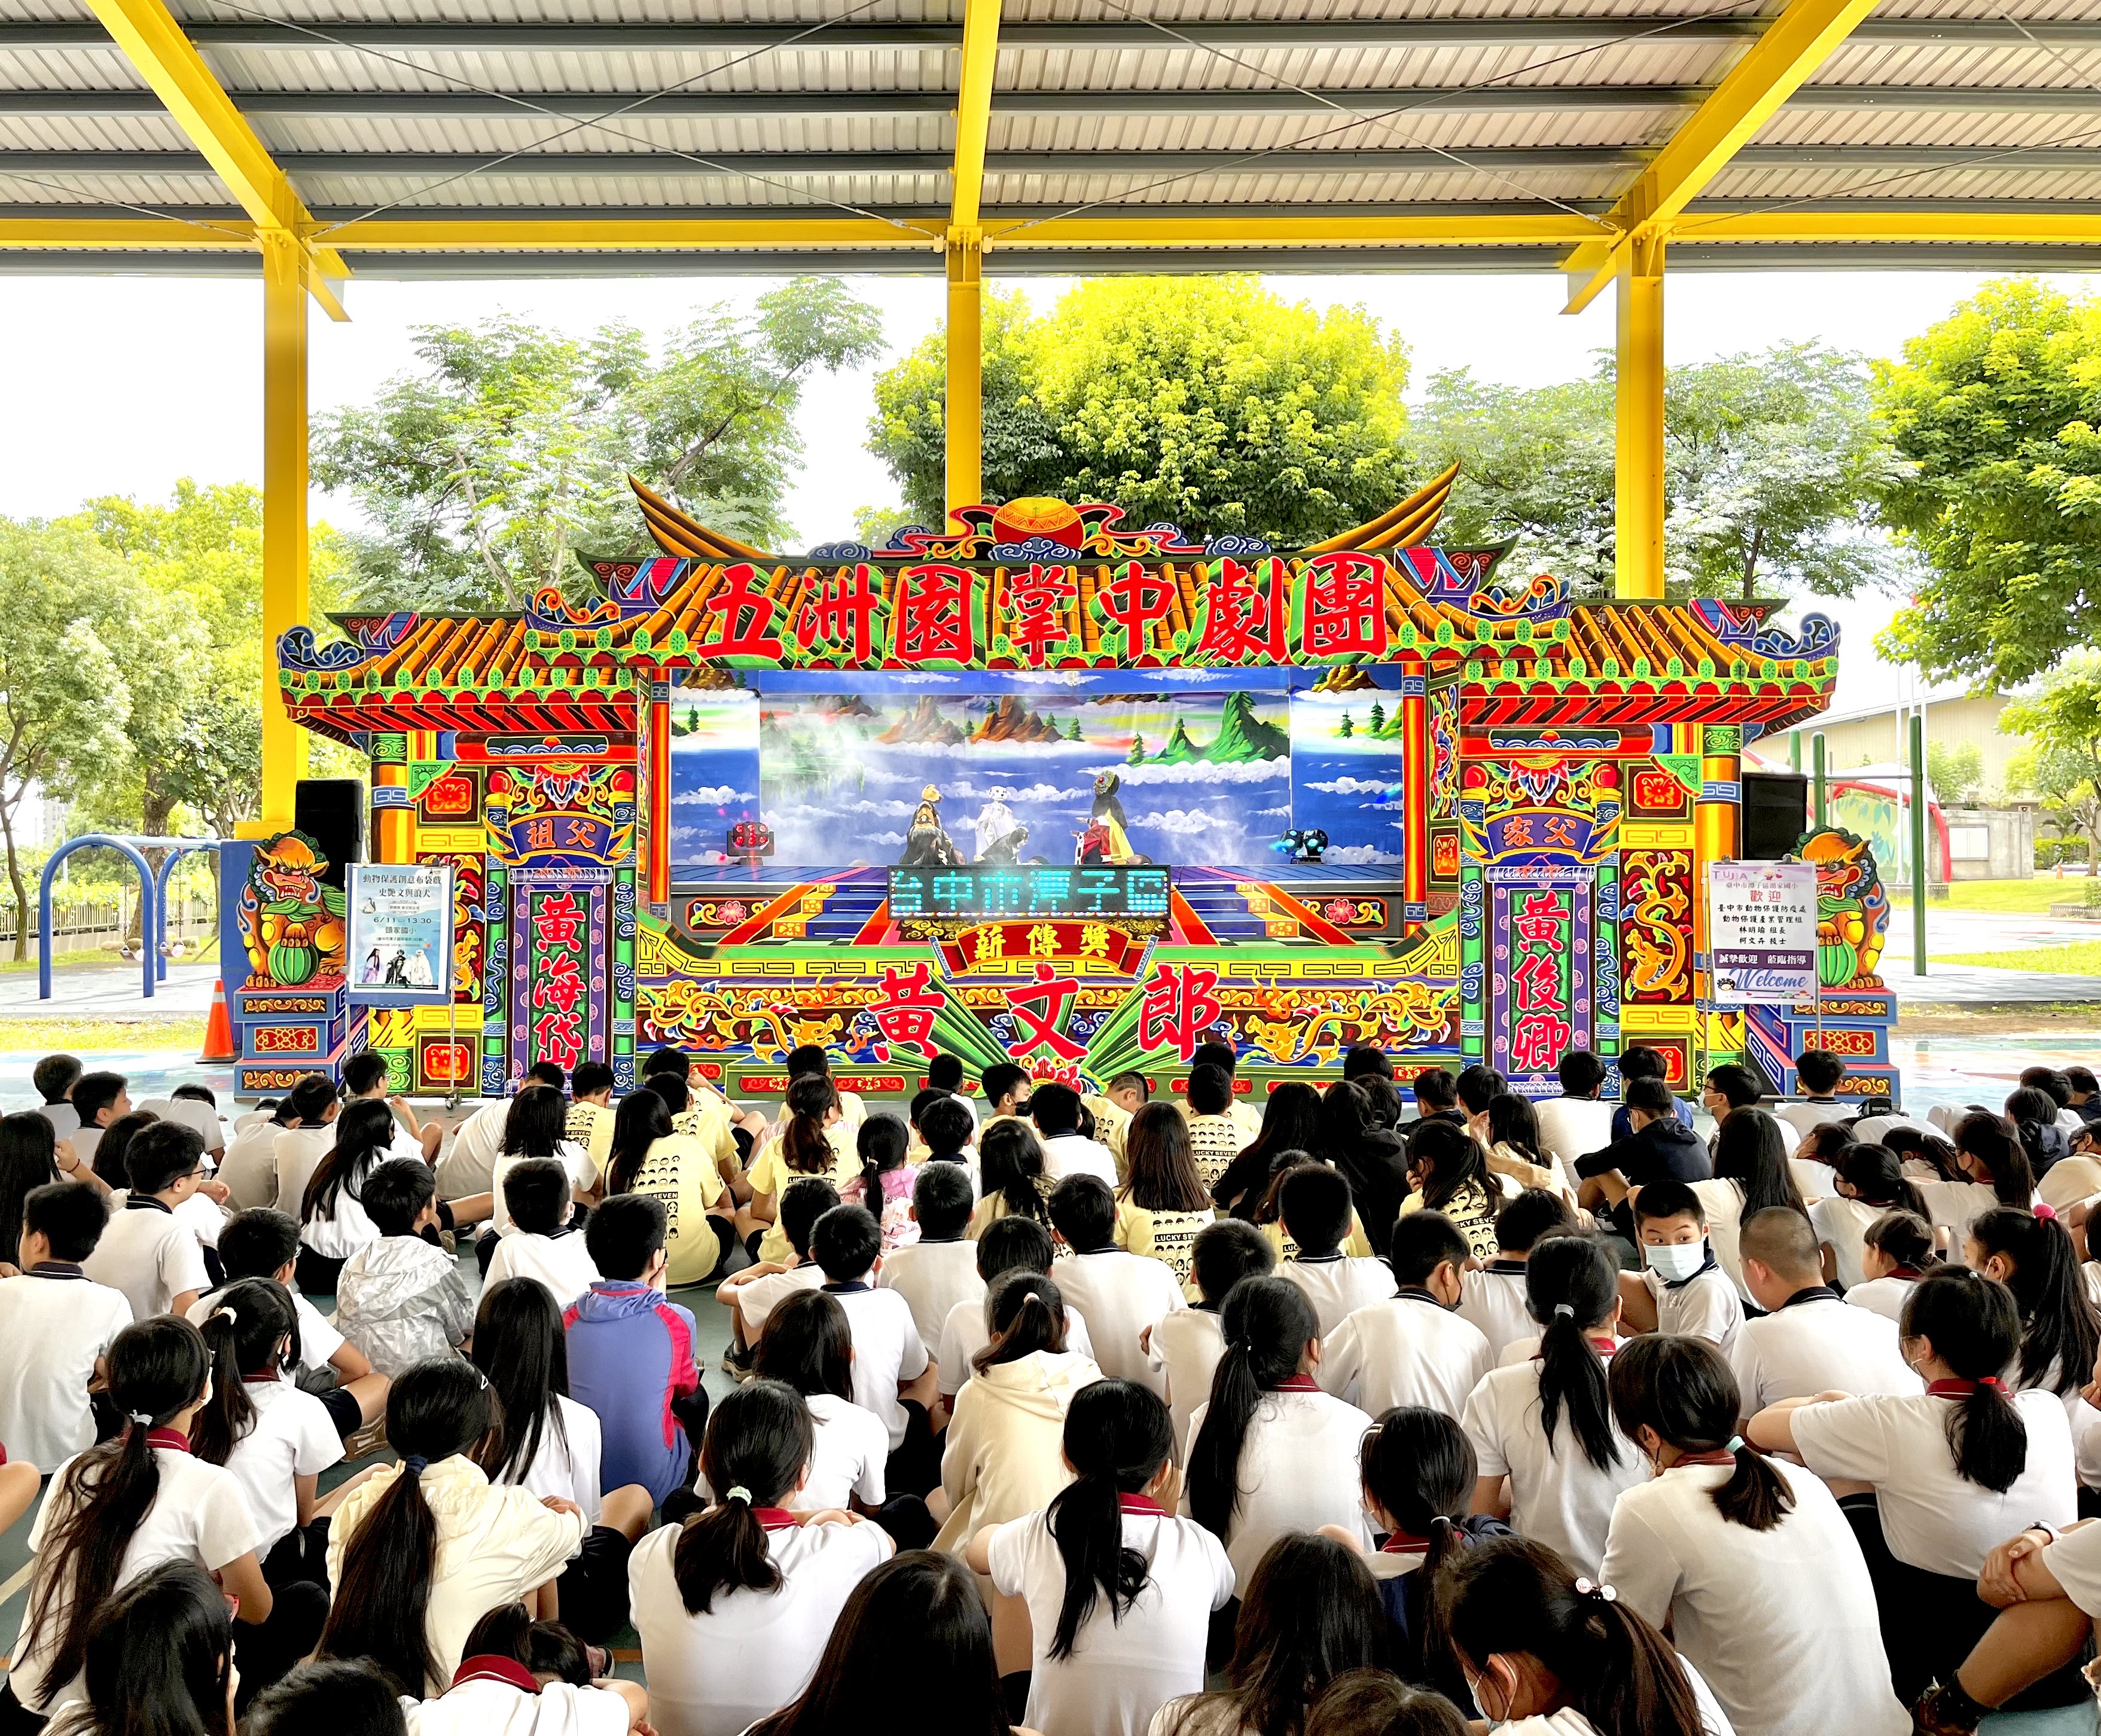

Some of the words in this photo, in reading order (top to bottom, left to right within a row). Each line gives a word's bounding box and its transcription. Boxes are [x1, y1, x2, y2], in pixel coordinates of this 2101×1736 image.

[696, 550, 1389, 666] 五洲園掌中劇團
[527, 819, 596, 849] 祖父
[1504, 816, 1576, 846] 家父
[363, 874, 441, 884] 動物保護創意布袋戲
[891, 870, 1168, 911] 台中市潭子區
[1713, 871, 1748, 880] TUJIA
[1750, 890, 1782, 903] 歡迎
[975, 924, 1110, 960] 薪傳獎
[532, 892, 587, 1071] 黃海岱
[1511, 890, 1571, 1072] 黃俊卿
[1729, 966, 1809, 988] Welcome
[865, 962, 1221, 1063] 黃文郎
[1473, 1216, 1495, 1225] SEVE
